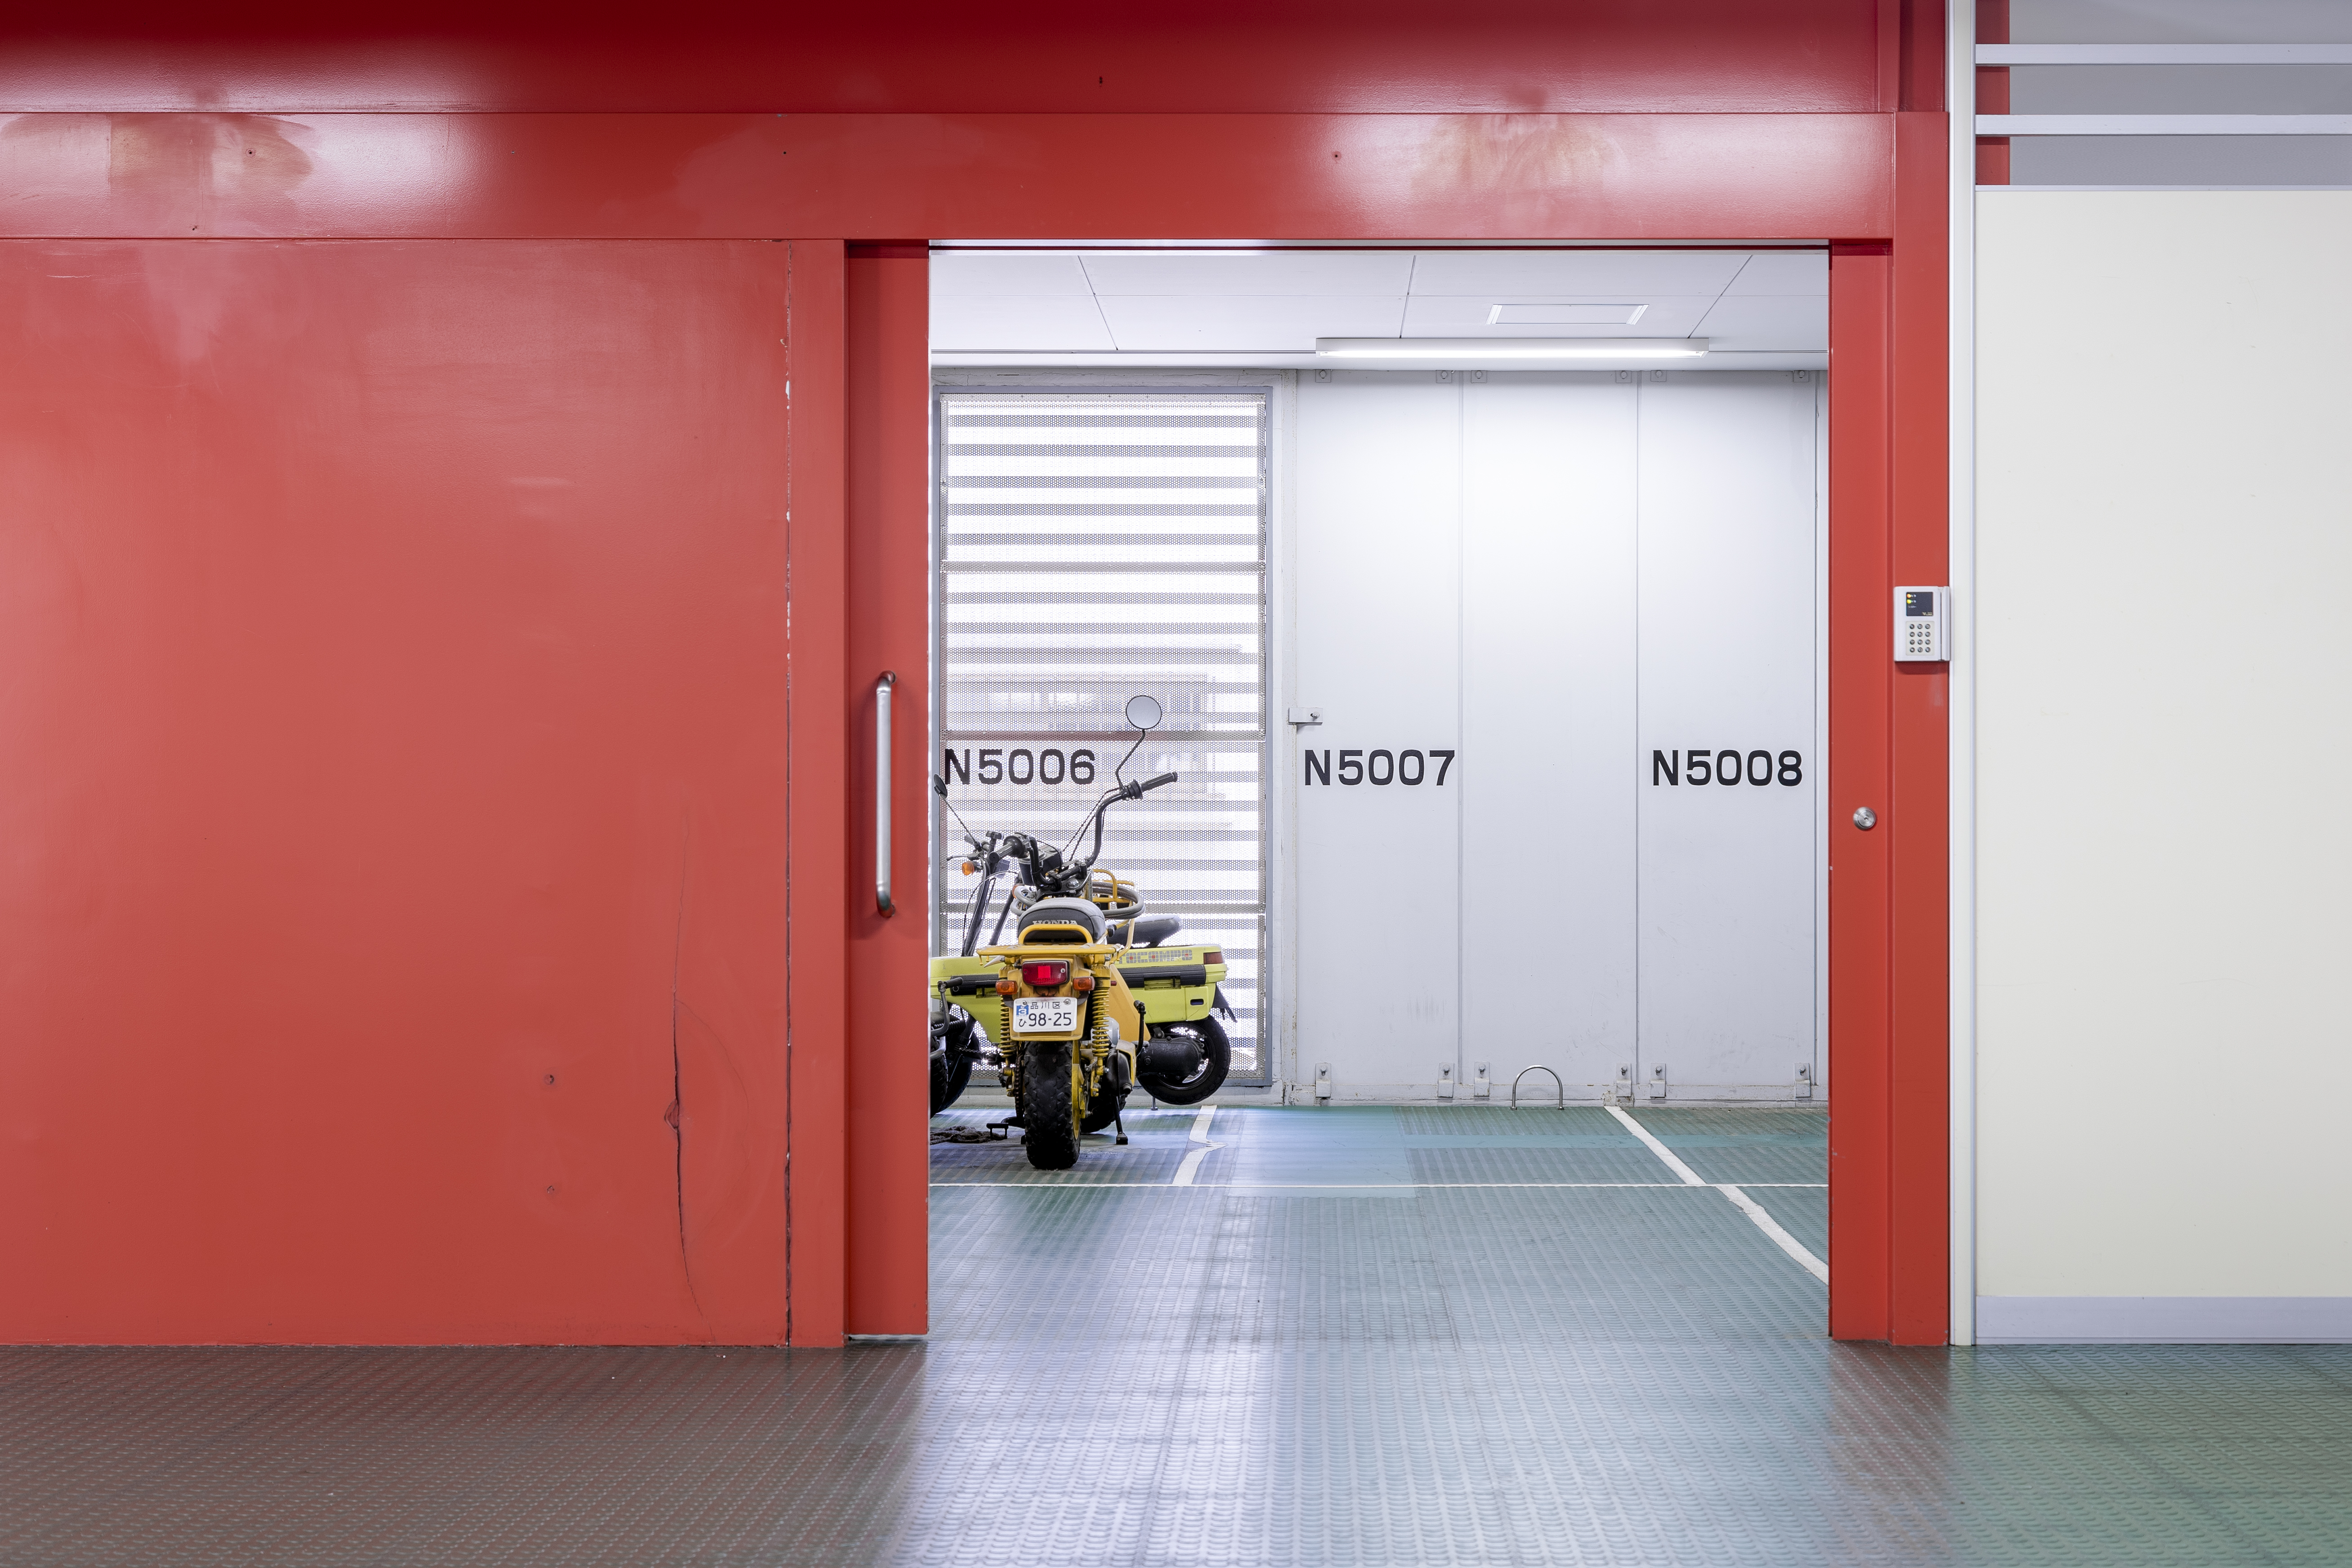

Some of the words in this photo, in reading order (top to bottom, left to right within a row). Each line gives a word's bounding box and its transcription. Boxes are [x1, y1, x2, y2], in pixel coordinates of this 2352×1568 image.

[945, 749, 1095, 785] N5006
[1305, 750, 1455, 786] N5007
[1653, 750, 1802, 786] N5008
[1019, 1019, 1027, 1027] ひ
[1028, 1012, 1072, 1027] 98-25
